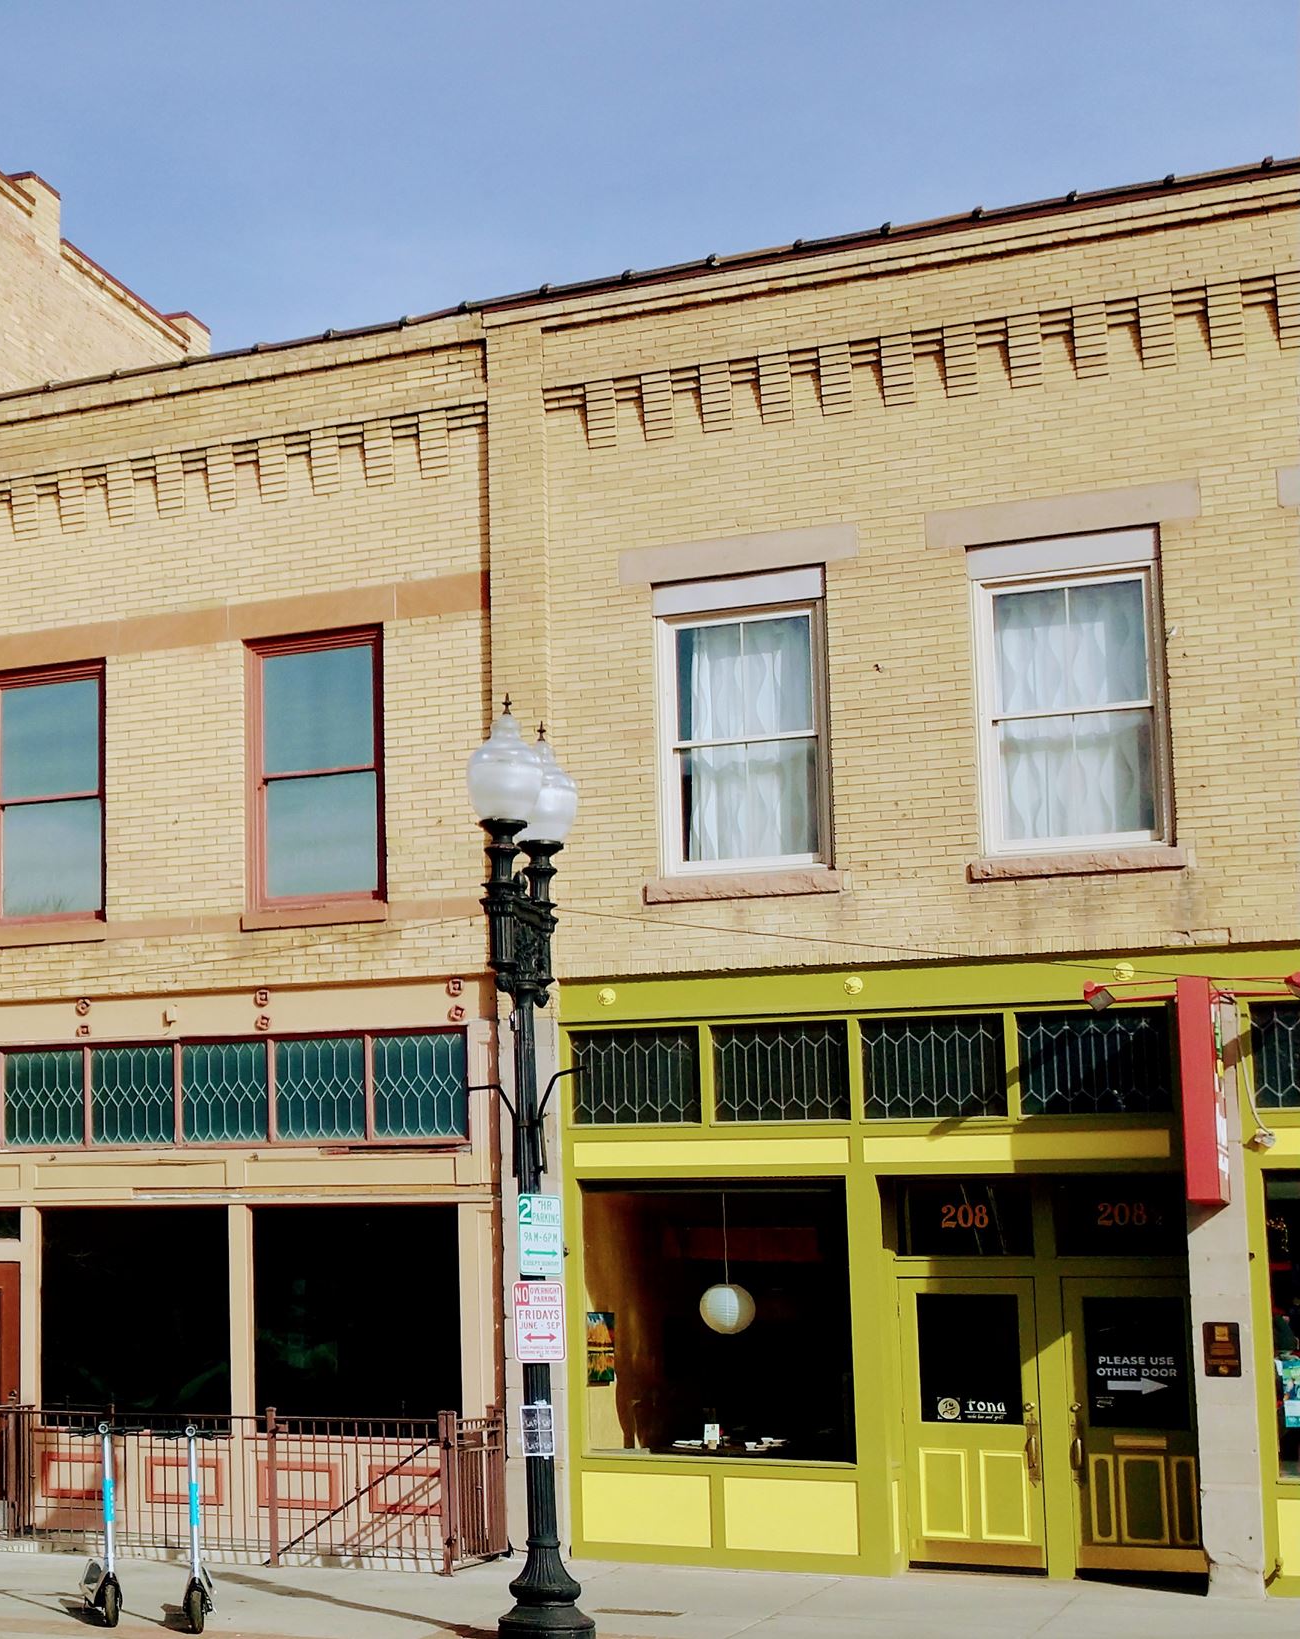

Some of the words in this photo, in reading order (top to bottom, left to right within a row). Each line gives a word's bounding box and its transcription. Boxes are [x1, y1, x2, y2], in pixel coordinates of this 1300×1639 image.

[519, 1198, 532, 1223] 2
[540, 1201, 552, 1211] HR
[533, 1212, 560, 1224] PARKING
[941, 1205, 988, 1228] 208
[1097, 1203, 1147, 1226] 208
[515, 1287, 528, 1303] NO
[530, 1287, 560, 1295] OVERNIGHT
[519, 1310, 560, 1320] FRIDAYS
[519, 1322, 538, 1330] JUNE
[546, 1322, 560, 1330] SEP
[1098, 1356, 1146, 1365] PLEASE
[1149, 1356, 1175, 1365] USE
[1096, 1368, 1137, 1377] OTHER
[1141, 1368, 1178, 1377] DOOR
